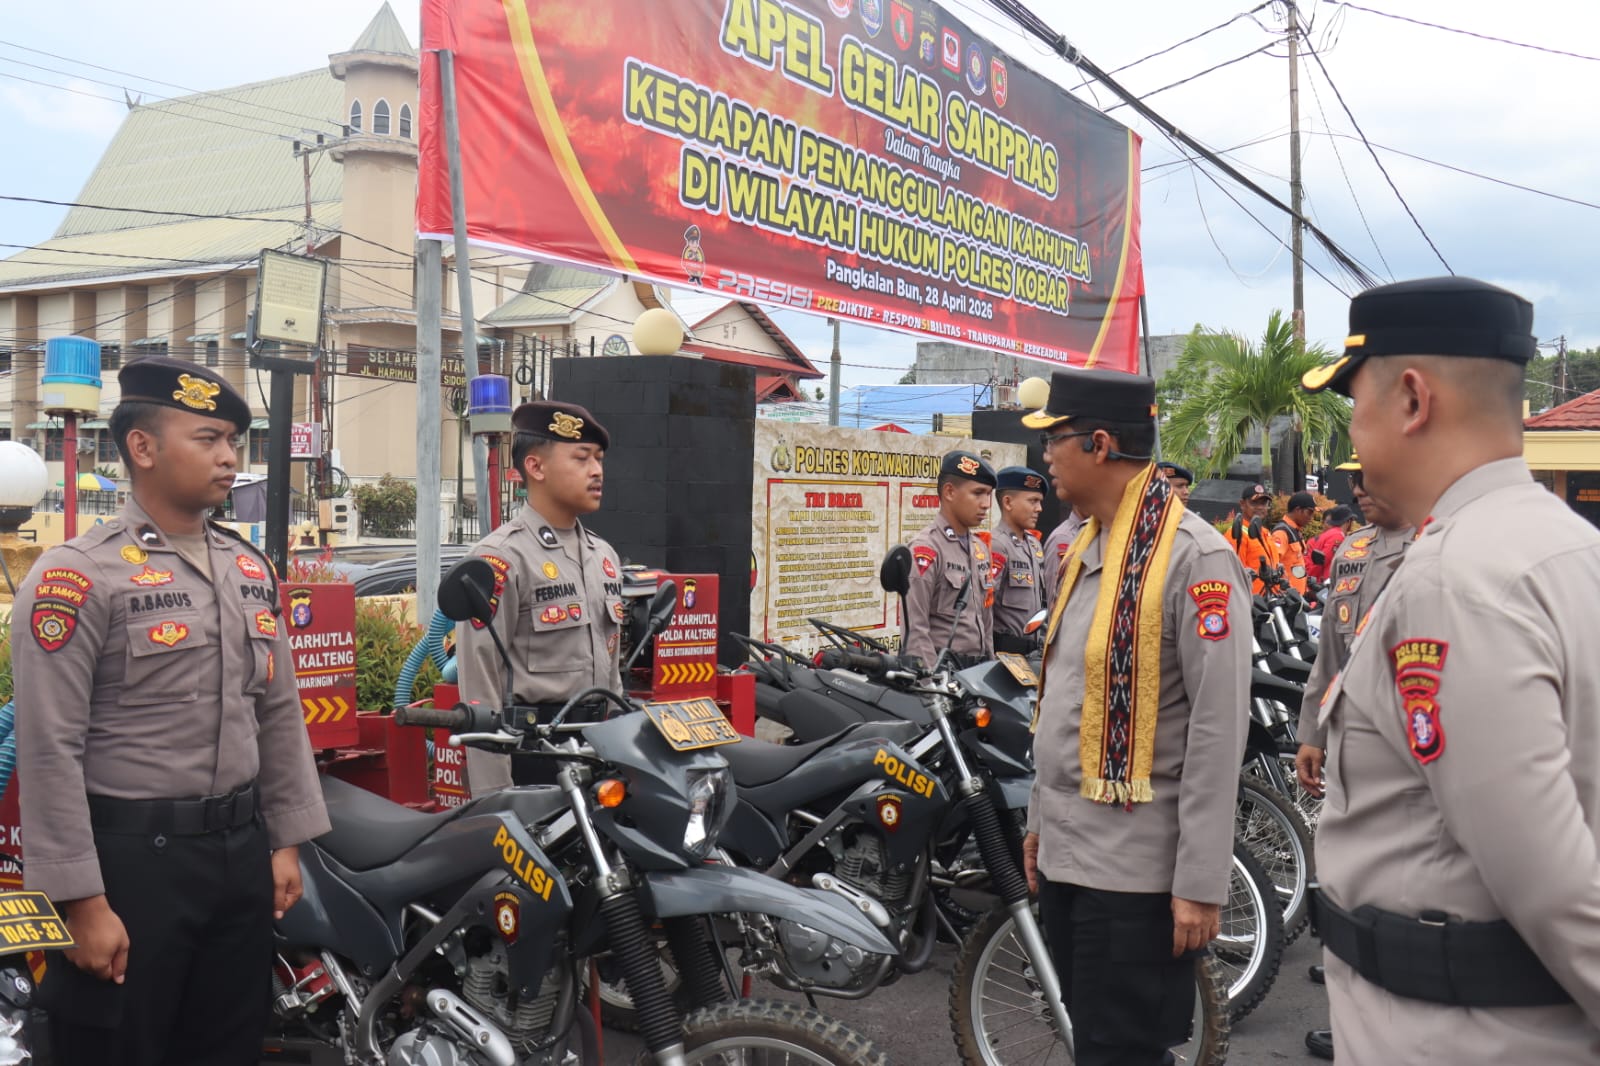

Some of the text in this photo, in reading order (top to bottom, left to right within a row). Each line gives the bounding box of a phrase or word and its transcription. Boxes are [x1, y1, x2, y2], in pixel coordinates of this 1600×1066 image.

[723, 0, 1059, 197] APEL GELAR SARPRAS
[885, 128, 961, 181] Dalam Rangka
[627, 66, 1091, 281] KESIAPAN PENANGGULANGAN KARHUTLA
[682, 149, 1069, 311] DI WILAYAH HUKUM POLRES KOBAR
[718, 268, 813, 309] PRESISI
[827, 258, 993, 320] Pangkalan Bun, 28 April 2026
[816, 295, 875, 319] PREDIKTIF
[882, 309, 961, 338] RESPONSIBILITAS
[967, 329, 1023, 352] TRANSPARANSI
[368, 351, 417, 368] SELAMA
[795, 446, 942, 479] POLRES KOTAWARINGIN
[240, 584, 275, 603] POL
[535, 582, 578, 602] FEBRIAN
[603, 582, 621, 596] POL
[1193, 582, 1228, 597] POLDA
[130, 591, 193, 613] R.BAGUS
[678, 613, 717, 626] KARHUTLA
[684, 627, 717, 641] KALTENG
[298, 651, 354, 669] KALTENG
[296, 674, 334, 689] AWARINGIN
[437, 747, 463, 766] URC
[436, 767, 463, 787] POL
[873, 748, 937, 800] POLISI
[492, 824, 556, 903] POLISI
